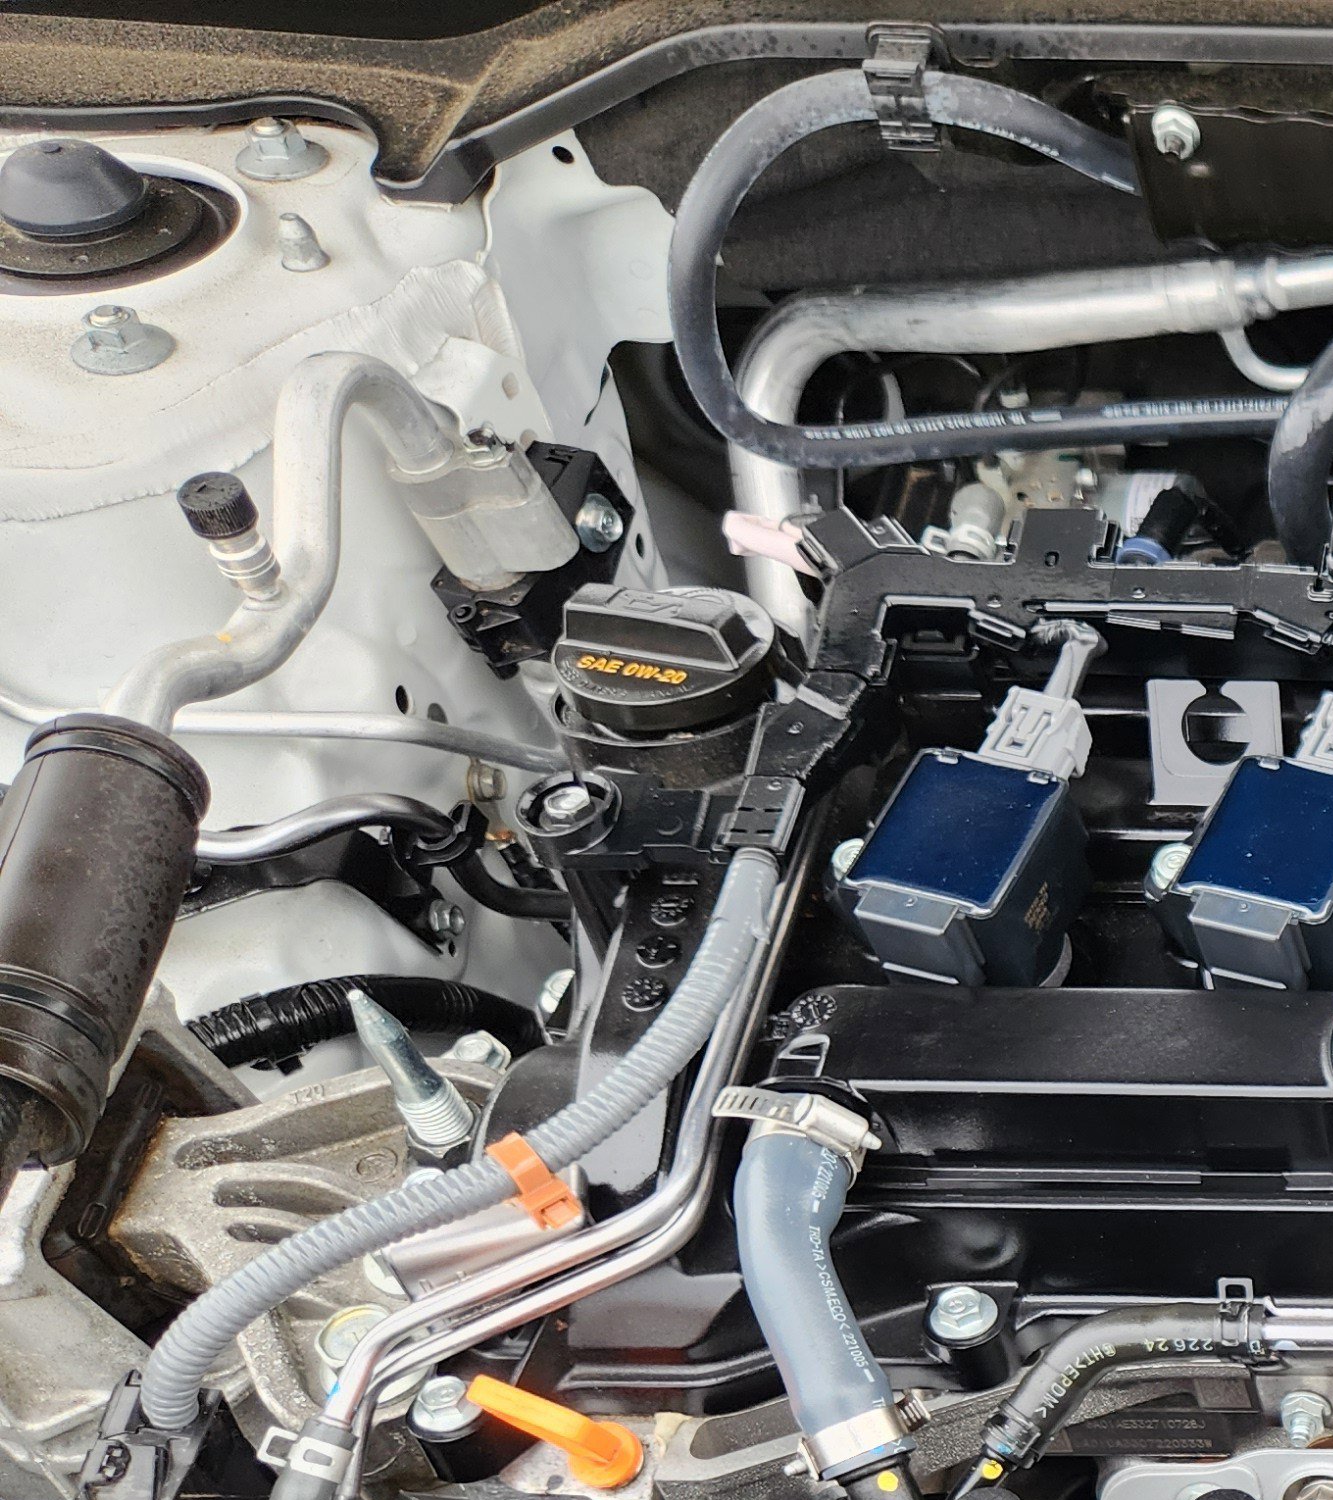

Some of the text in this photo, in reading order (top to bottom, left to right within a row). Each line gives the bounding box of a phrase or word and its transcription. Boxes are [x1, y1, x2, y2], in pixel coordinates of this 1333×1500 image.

[576, 655, 689, 686] SAE 0W-20
[842, 1332, 870, 1369] 221005
